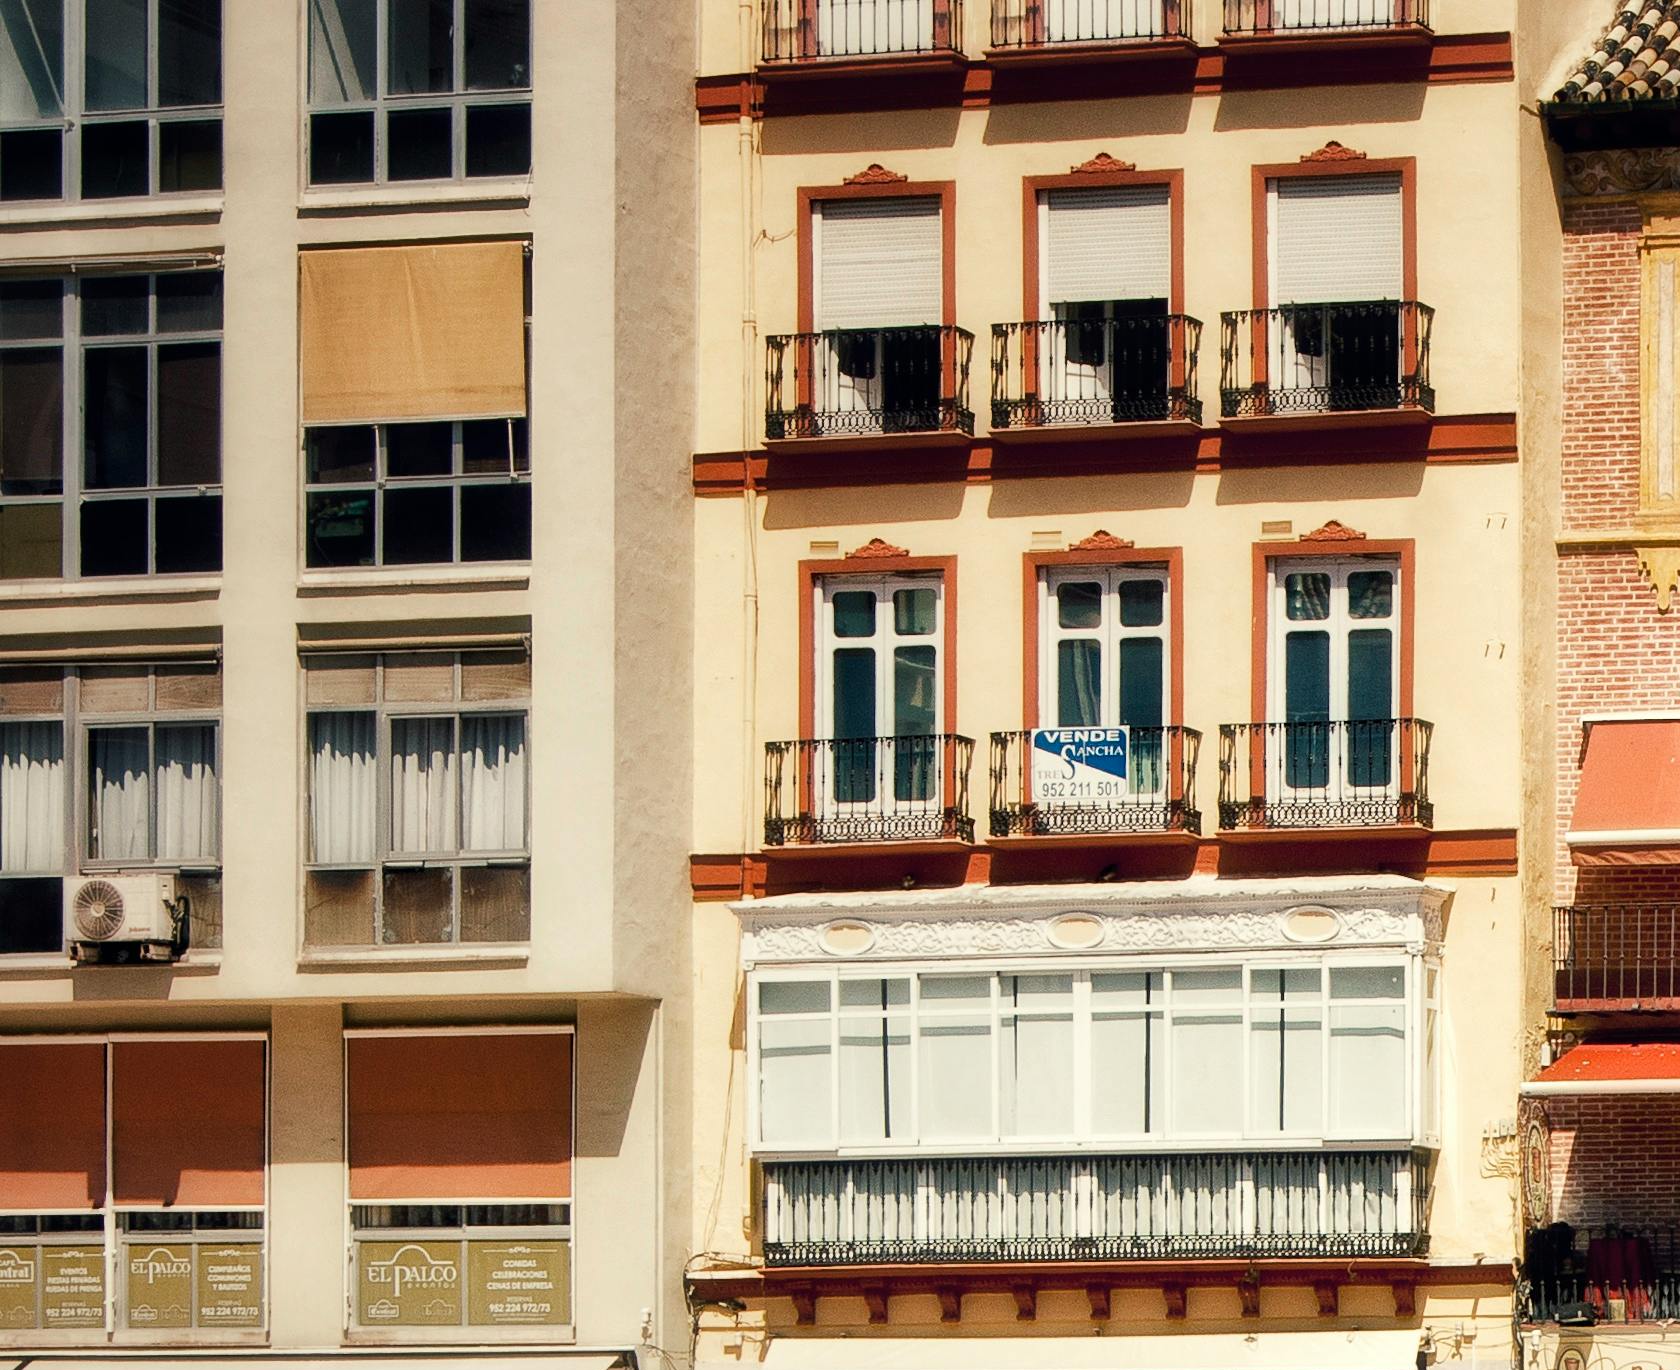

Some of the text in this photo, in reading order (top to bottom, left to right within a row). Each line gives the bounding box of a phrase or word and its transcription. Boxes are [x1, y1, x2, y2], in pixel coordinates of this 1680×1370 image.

[1044, 729, 1120, 743] VENDE
[1043, 782, 1119, 797] 952 211 501
[503, 1259, 537, 1268] COMIDAS
[131, 1261, 191, 1284] EL PALCO
[367, 1265, 457, 1297] EL PALCO
[46, 1307, 60, 1317] 952
[201, 1306, 215, 1316] 952
[489, 1303, 551, 1313] 952 224 972/73
